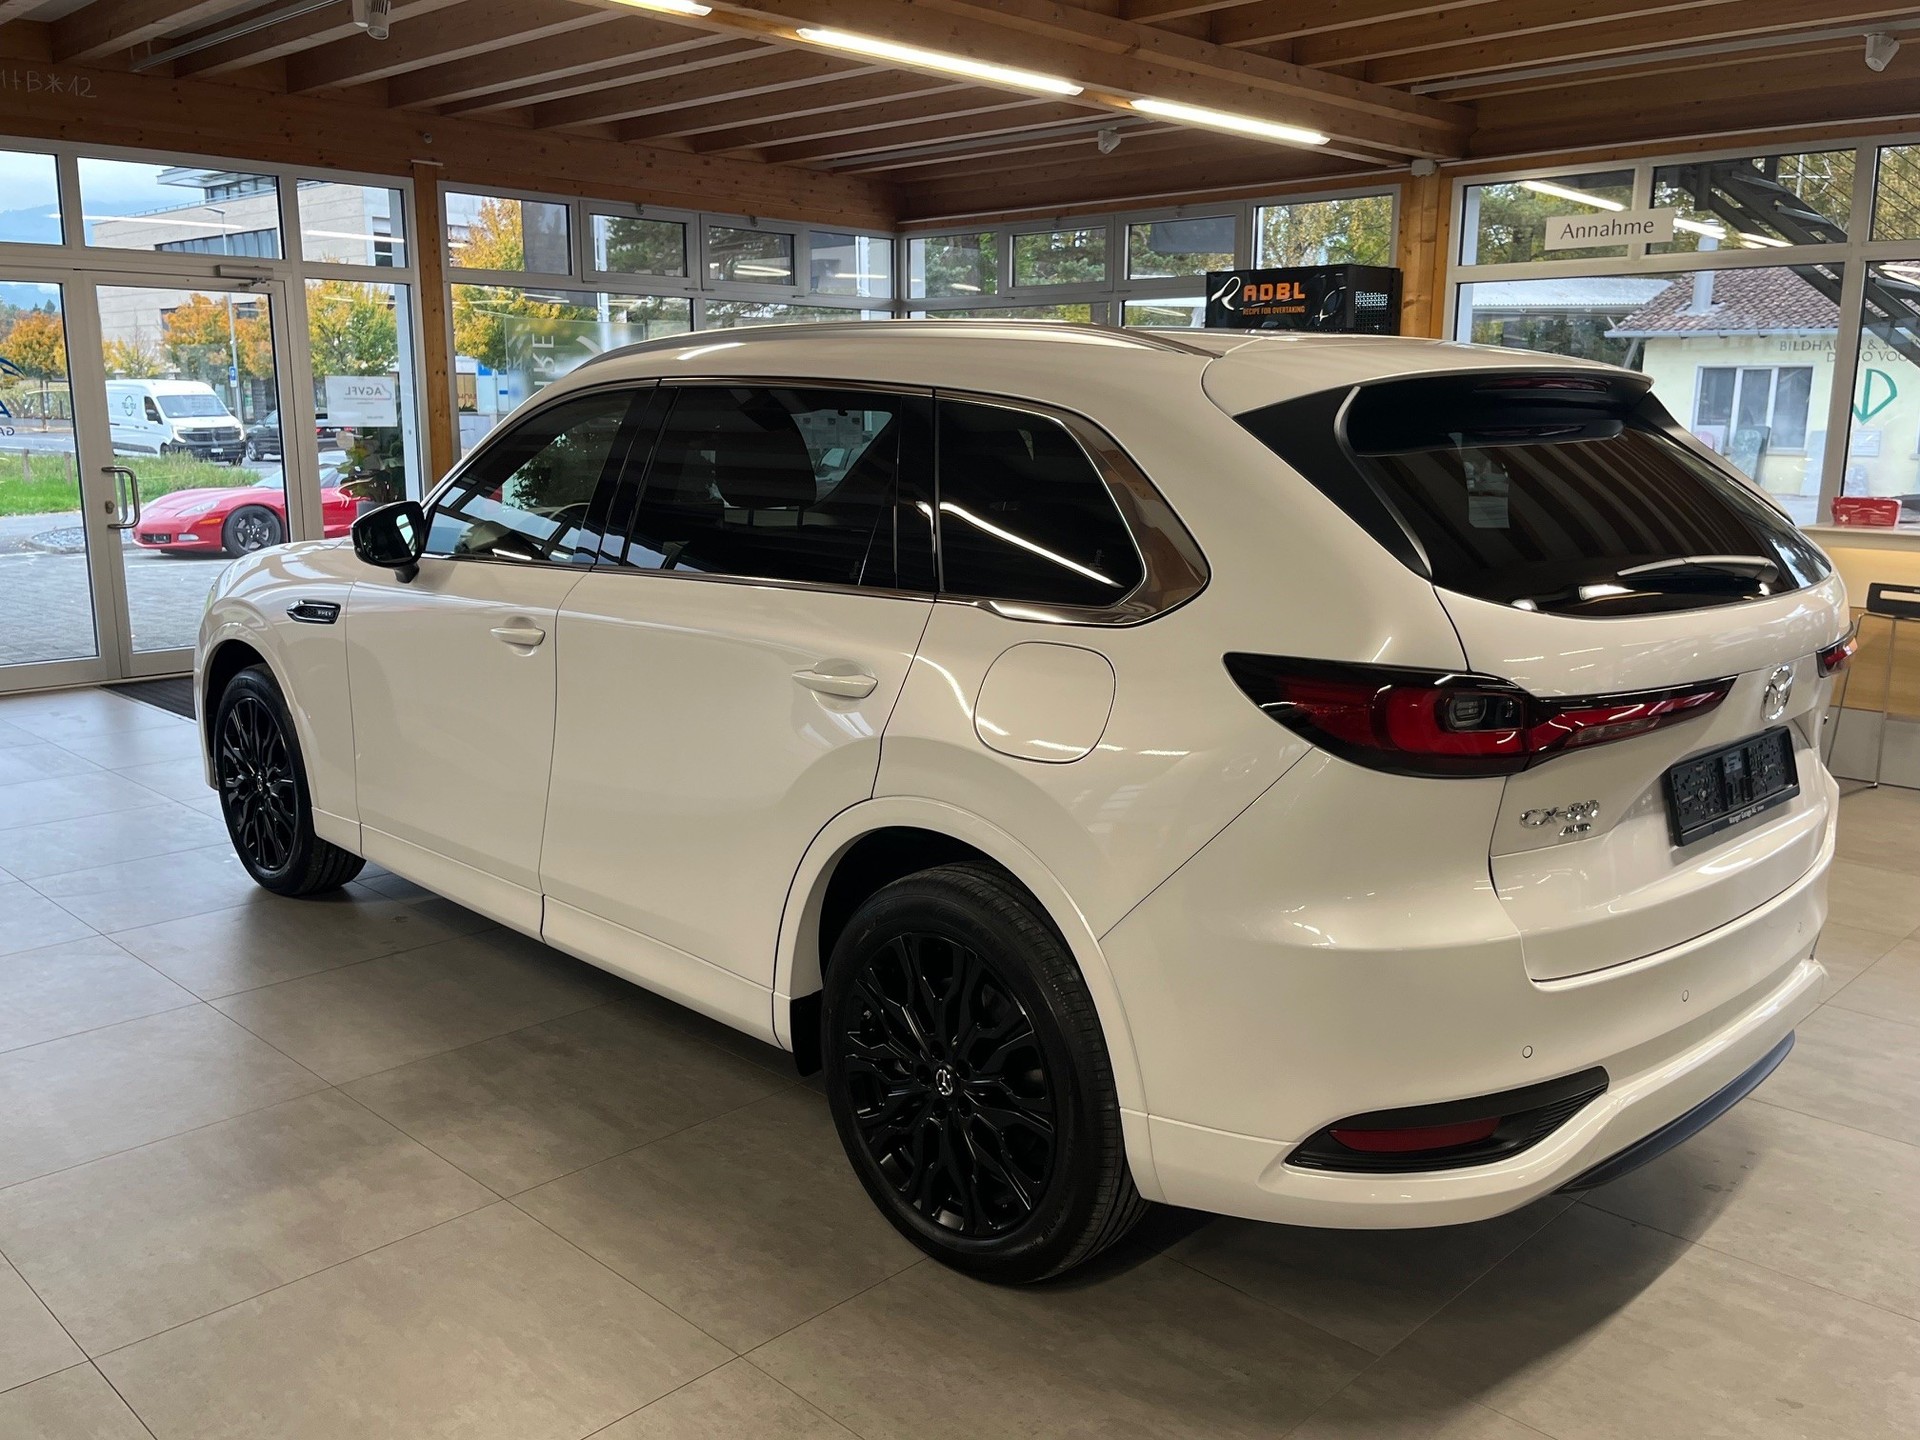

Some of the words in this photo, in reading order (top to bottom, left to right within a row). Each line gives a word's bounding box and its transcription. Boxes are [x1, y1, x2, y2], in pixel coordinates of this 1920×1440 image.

[1560, 218, 1655, 240] Annahme
[1243, 282, 1306, 302] ADBL
[1261, 306, 1271, 315] FOR
